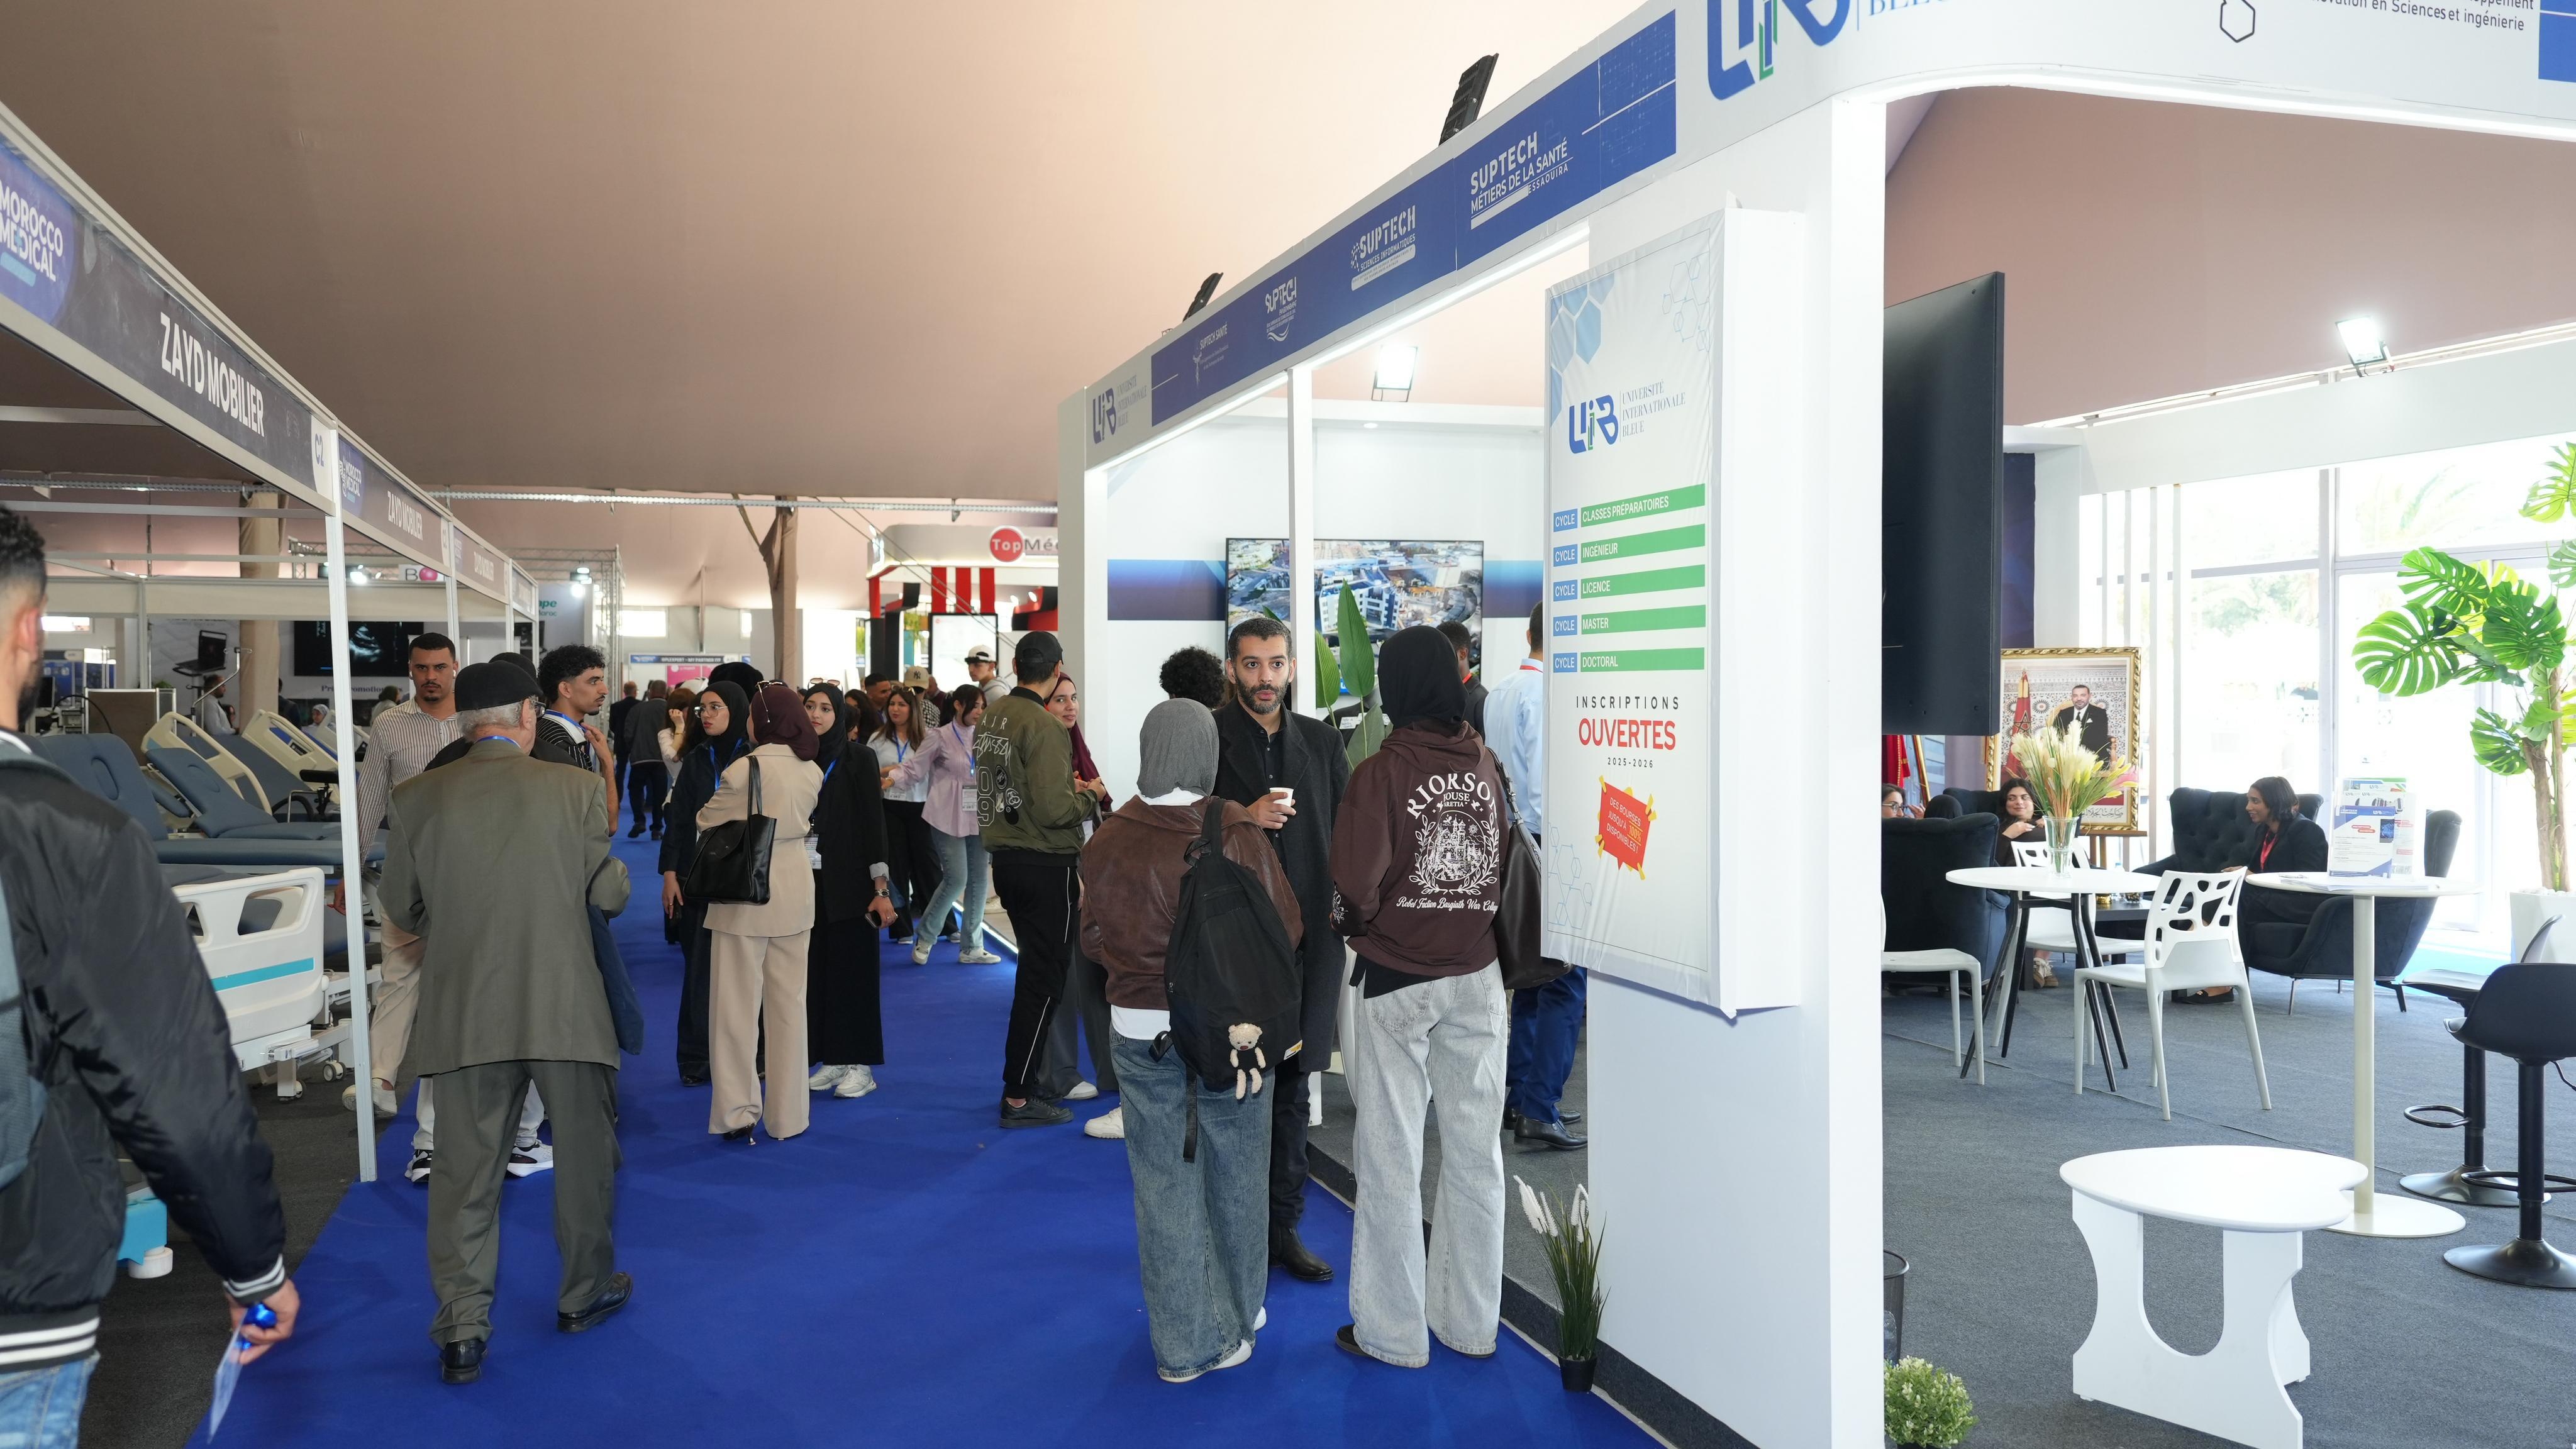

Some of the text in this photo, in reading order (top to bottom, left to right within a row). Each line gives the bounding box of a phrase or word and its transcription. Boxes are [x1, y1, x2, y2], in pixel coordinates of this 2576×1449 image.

[2372, 0, 2387, 11] en
[2392, 1, 2446, 20] Sciences
[2448, 8, 2460, 21] et
[2464, 10, 2524, 31] ingénierie
[1470, 131, 1538, 195] SUPTECH
[1471, 136, 1568, 214] MÉTIERS DE LA SANTÉ
[1528, 163, 1568, 194] ESSAOUIRA
[0, 180, 64, 257] MOROCCO
[1360, 205, 1416, 259] SUPTECH
[0, 212, 57, 282] MEDICAL
[1361, 253, 1380, 271] SCIENCES
[1380, 233, 1416, 259] INFORMATIQUES
[1200, 321, 1228, 350] SUPTECH SANTÉ
[160, 311, 265, 438] ZAYD MOBILIER
[1622, 379, 1664, 405] UNIVERSITÉ
[1623, 392, 1686, 421] INTERNATIONALE
[1623, 420, 1645, 438] BLEUE
[315, 433, 324, 467] C2
[345, 460, 362, 482] MOROCCO
[346, 473, 360, 497] MEDICAL
[387, 490, 423, 541] ZAYD MOBILIER
[1555, 496, 1669, 528] CYCLE CLASSES PRÉPARATOIRES
[992, 538, 1058, 553] TopMé
[1555, 543, 1618, 563] CYCLE INGÉNIEUR
[1555, 580, 1611, 597] CYCLE LICENCE
[1555, 617, 1609, 631] CYCLE MASTER
[1555, 656, 1618, 669] CYCLE DOCTORAL
[1576, 696, 1679, 710] INSCRIPTIONS
[1579, 718, 1676, 750] OUVERTES
[1607, 757, 1653, 768] 2025-2026
[1609, 797, 1641, 827] DES BOURSES
[1606, 823, 1636, 852] DISPONIBLES
[1629, 824, 1641, 843] 100%
[1396, 896, 1416, 908] Rebel
[1416, 897, 1437, 909] Faction
[1437, 897, 1465, 911] Basgiath
[1467, 898, 1481, 910] War
